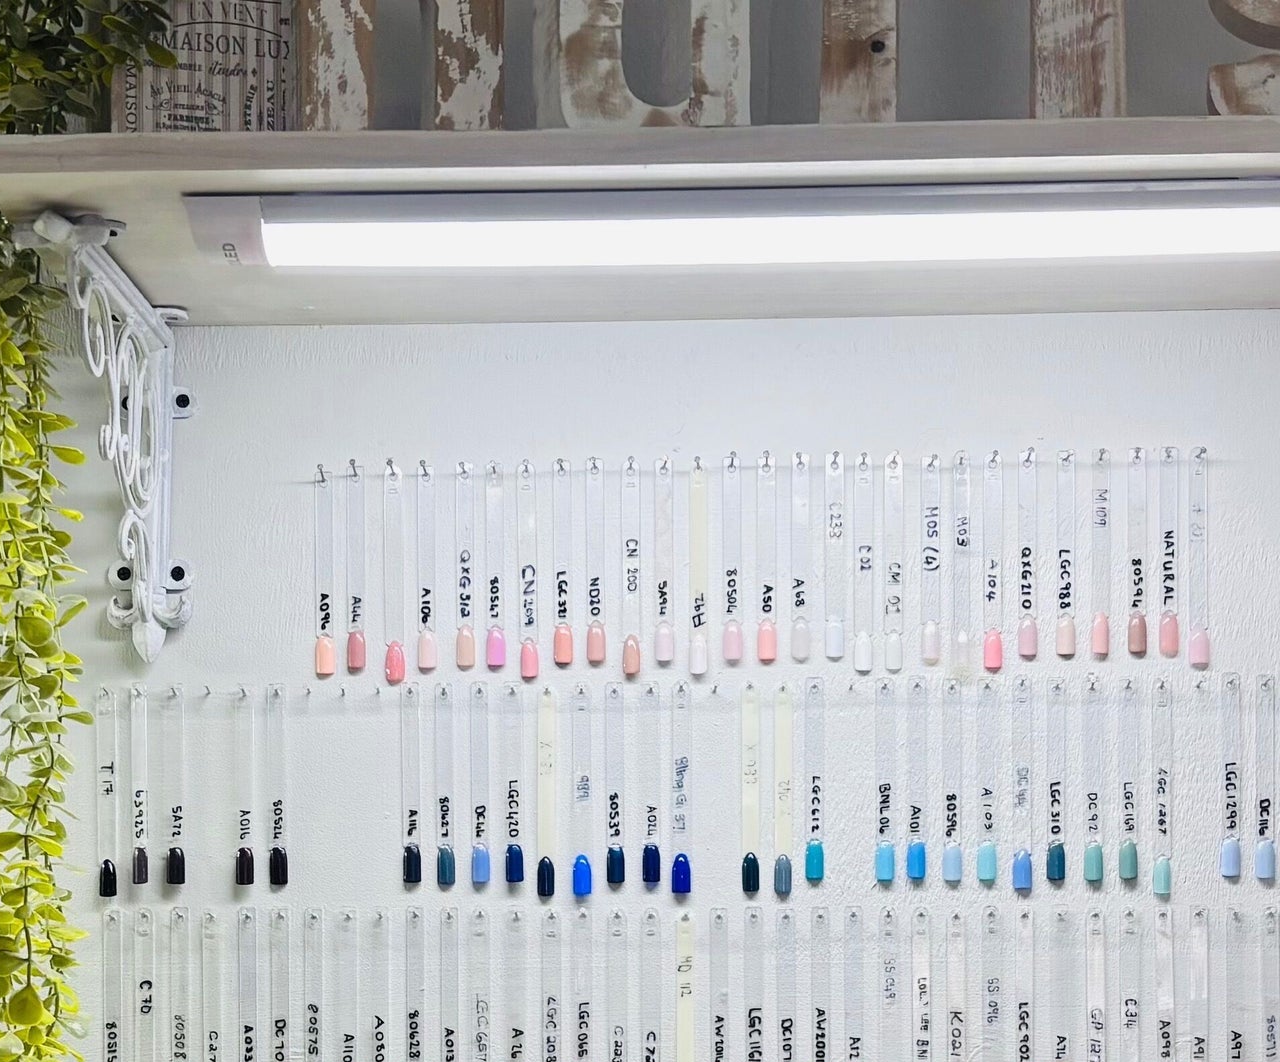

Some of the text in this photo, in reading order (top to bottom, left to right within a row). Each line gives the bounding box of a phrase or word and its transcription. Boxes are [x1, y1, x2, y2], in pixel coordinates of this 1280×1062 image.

[160, 30, 246, 56] MAISON
[1163, 531, 1174, 605] NATURAL
[409, 1010, 420, 1058] 80628
